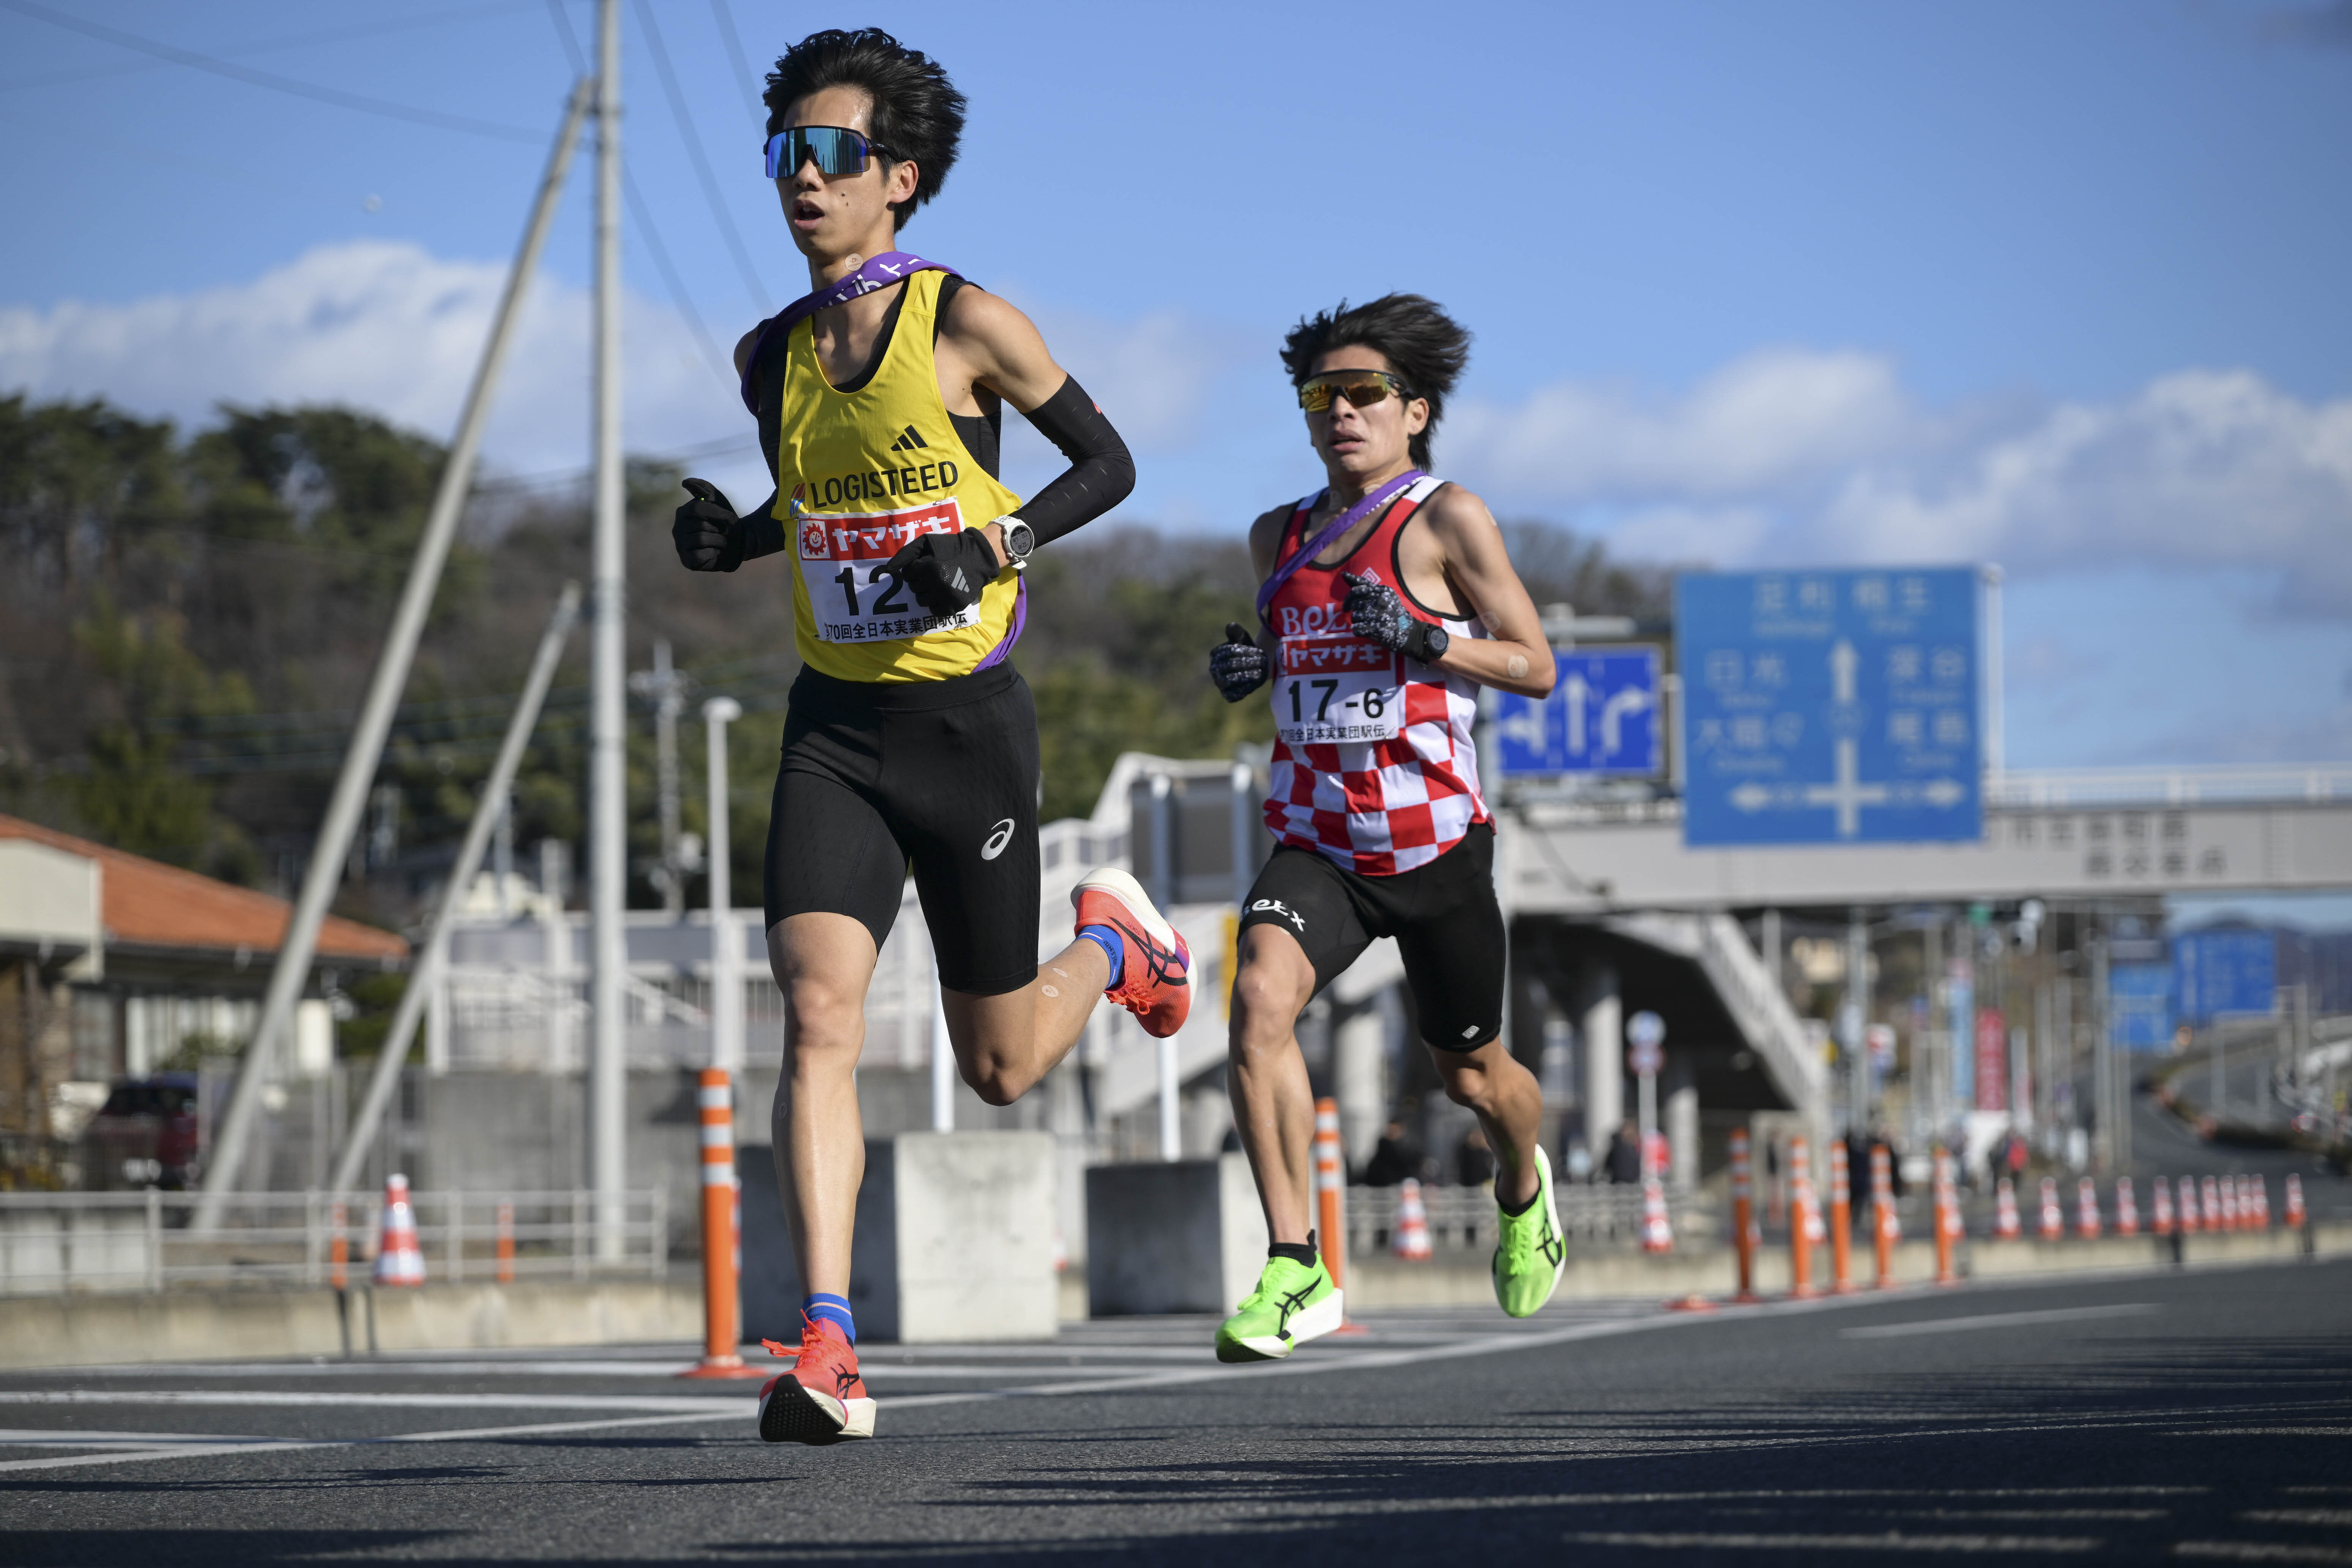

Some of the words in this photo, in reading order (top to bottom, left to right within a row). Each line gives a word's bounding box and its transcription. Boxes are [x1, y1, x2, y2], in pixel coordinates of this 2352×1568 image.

[810, 461, 958, 509] LOGISTEED
[832, 516, 952, 551] ヤマザキ
[1289, 643, 1383, 668] ヤマザキ
[1288, 679, 1384, 722] 17-6
[1279, 724, 1385, 741] 回全日本実業団駅伝
